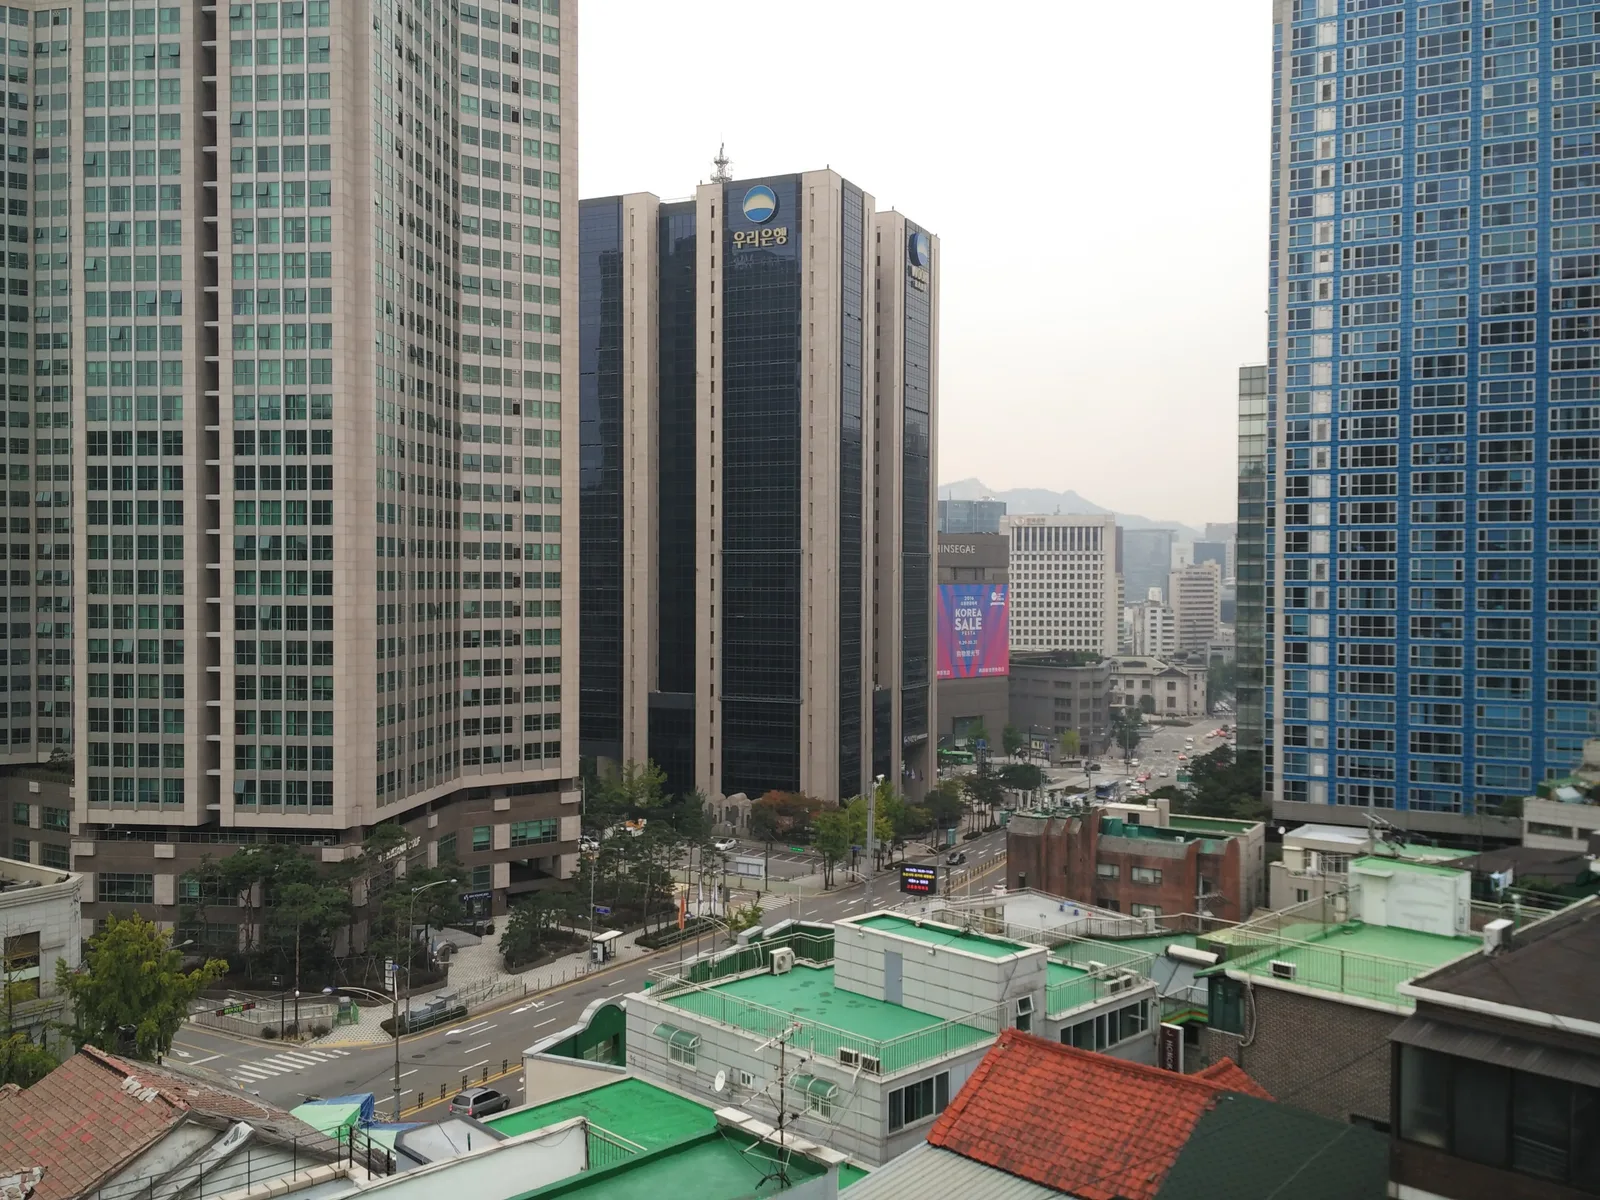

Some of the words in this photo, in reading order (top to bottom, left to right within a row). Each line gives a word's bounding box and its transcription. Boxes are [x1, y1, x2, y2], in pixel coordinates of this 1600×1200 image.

[733, 227, 788, 249] 우리은행
[955, 608, 982, 618] KOREA
[955, 618, 982, 631] SALE
